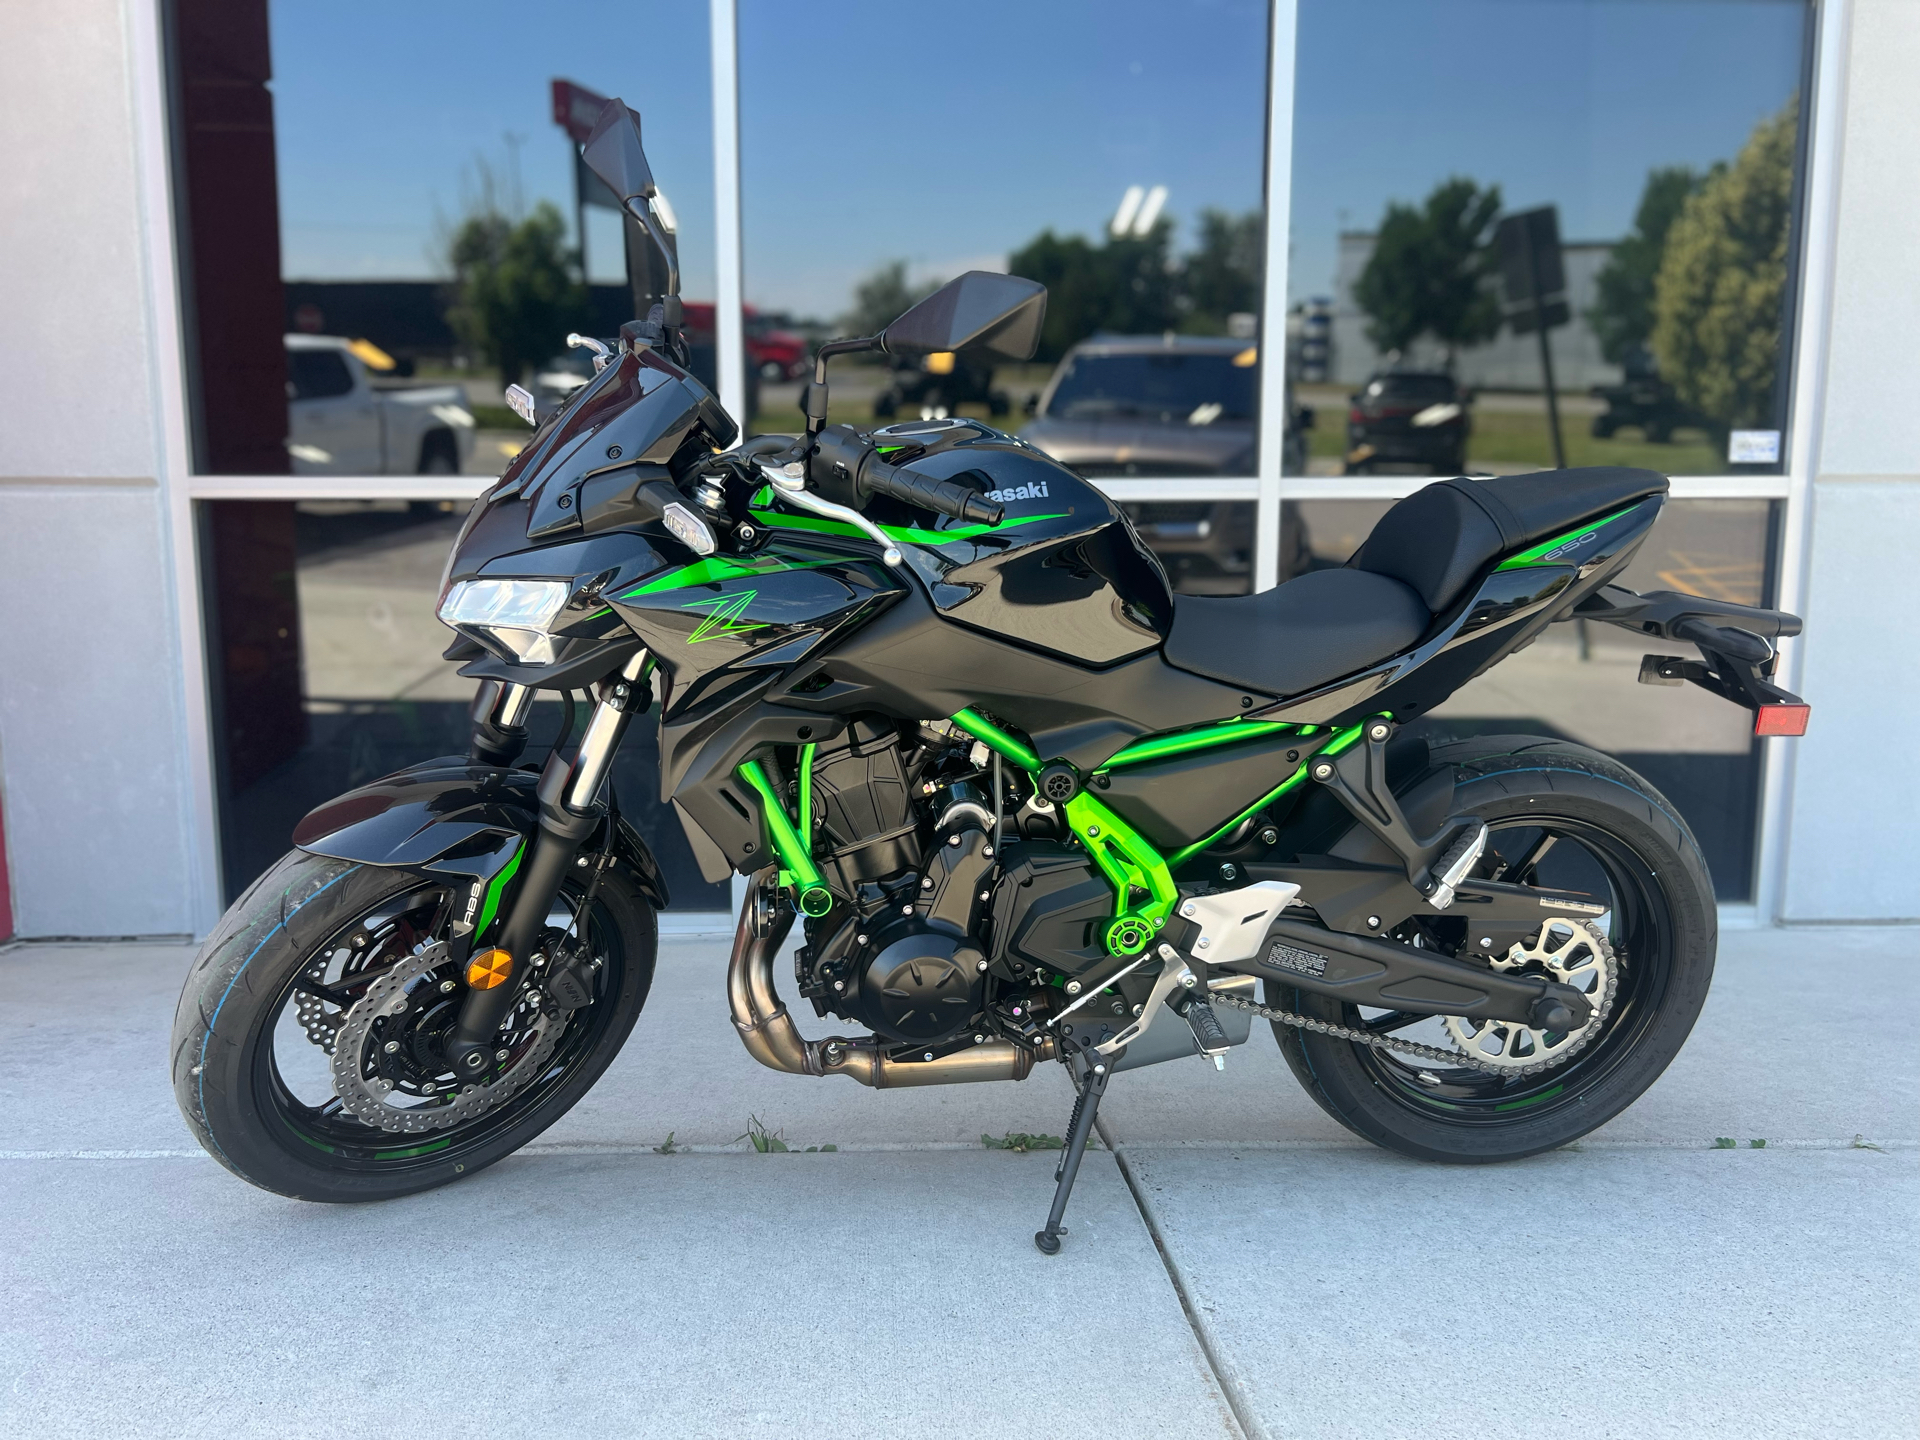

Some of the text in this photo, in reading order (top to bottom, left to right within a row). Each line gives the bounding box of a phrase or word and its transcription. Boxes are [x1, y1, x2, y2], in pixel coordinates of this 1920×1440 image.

[984, 481, 1049, 503] asaki
[1544, 531, 1597, 561] 650
[463, 882, 481, 926] ABS
